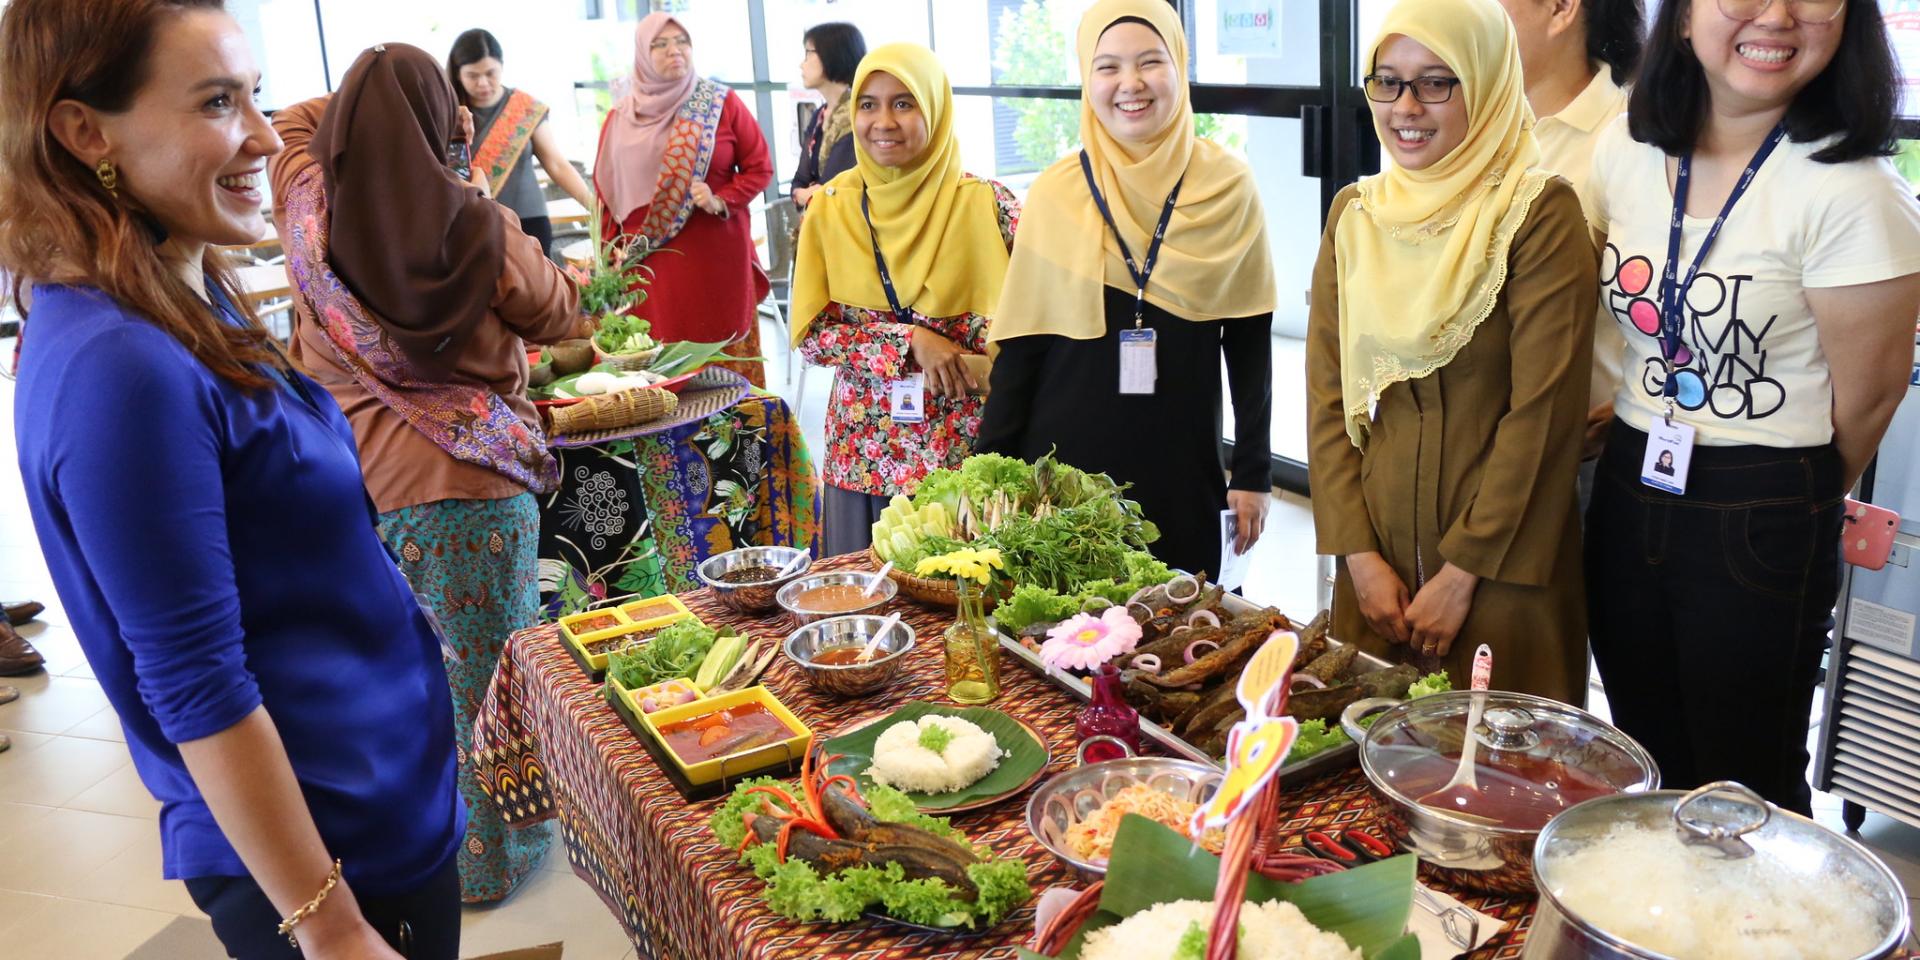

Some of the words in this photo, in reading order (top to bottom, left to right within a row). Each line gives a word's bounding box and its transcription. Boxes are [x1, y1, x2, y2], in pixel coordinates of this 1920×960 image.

[1610, 289, 1662, 337] FO
[1691, 313, 1778, 355] MY
[1643, 357, 1786, 419] GOOD
